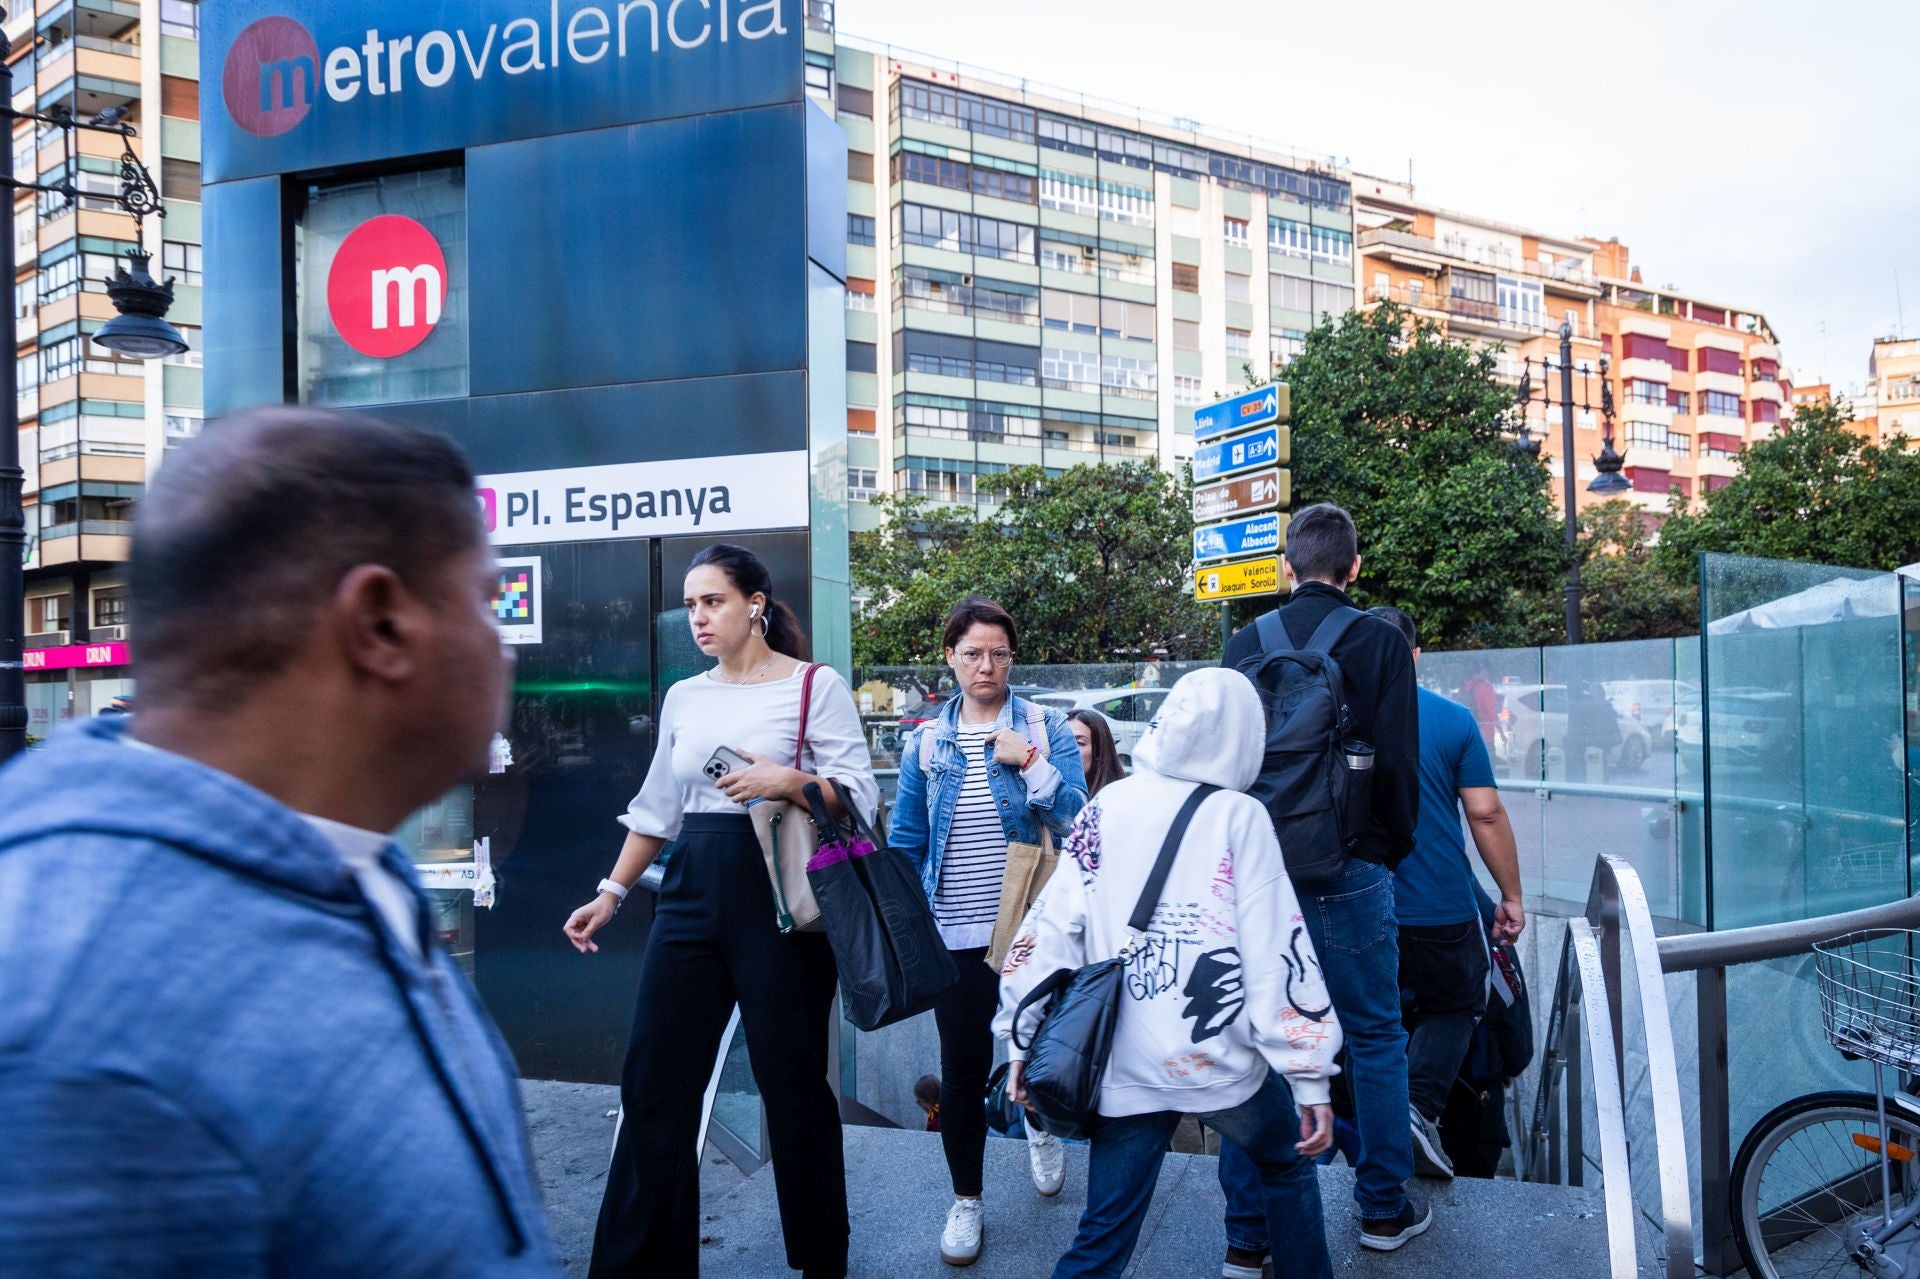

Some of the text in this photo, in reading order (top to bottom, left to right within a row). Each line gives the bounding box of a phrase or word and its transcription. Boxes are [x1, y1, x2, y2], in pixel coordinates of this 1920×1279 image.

[1195, 487, 1230, 505] Palau de
[507, 490, 551, 527] Pl.
[565, 485, 731, 530] Espanya
[1245, 519, 1277, 535] Alacant
[1241, 531, 1277, 549] Albacete
[1251, 577, 1276, 590] Sorolla
